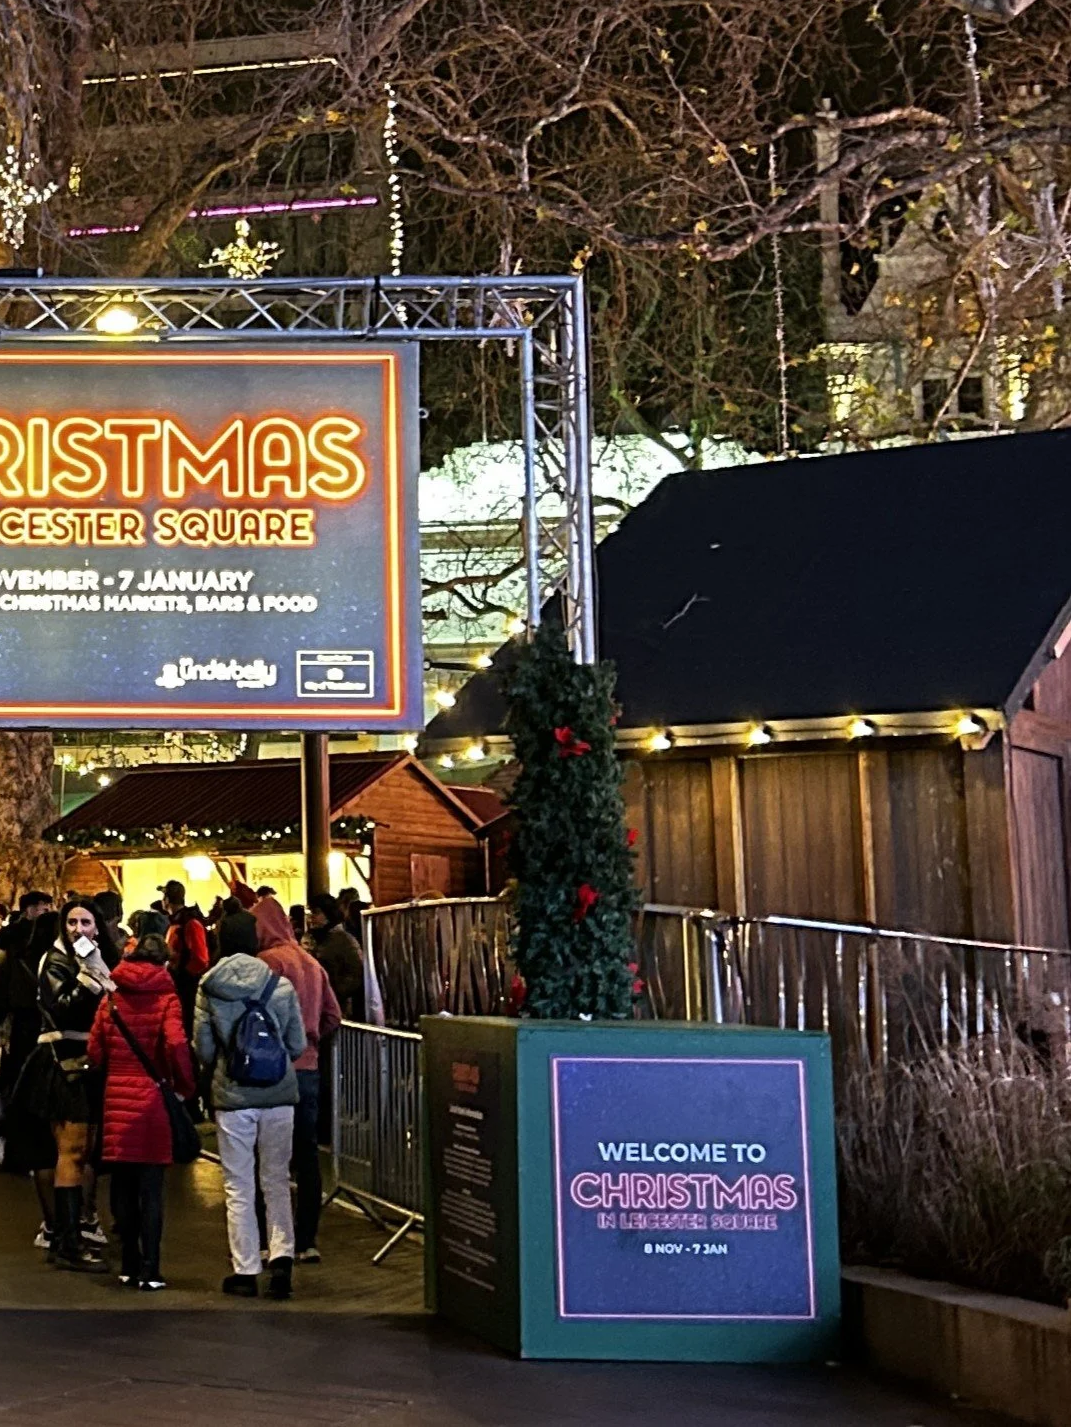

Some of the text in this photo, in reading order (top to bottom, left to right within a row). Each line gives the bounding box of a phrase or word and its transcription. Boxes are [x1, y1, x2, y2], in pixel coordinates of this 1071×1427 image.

[153, 507, 316, 546] SQUARE
[118, 570, 135, 591] 7
[137, 569, 255, 591] JANUARY
[0, 593, 101, 612] CHRISTMAS
[103, 594, 193, 614] MARKETS,
[195, 594, 245, 612] BARS
[263, 594, 318, 613] FOOD
[598, 1142, 766, 1163] WELCOME TO
[570, 1172, 798, 1210] CHRISTMAS
[597, 1212, 778, 1231] IN LEICESTER SQUARE
[644, 1243, 653, 1254] 8
[655, 1243, 682, 1255] NOV
[693, 1244, 701, 1255] 7
[702, 1243, 729, 1255] JAN
